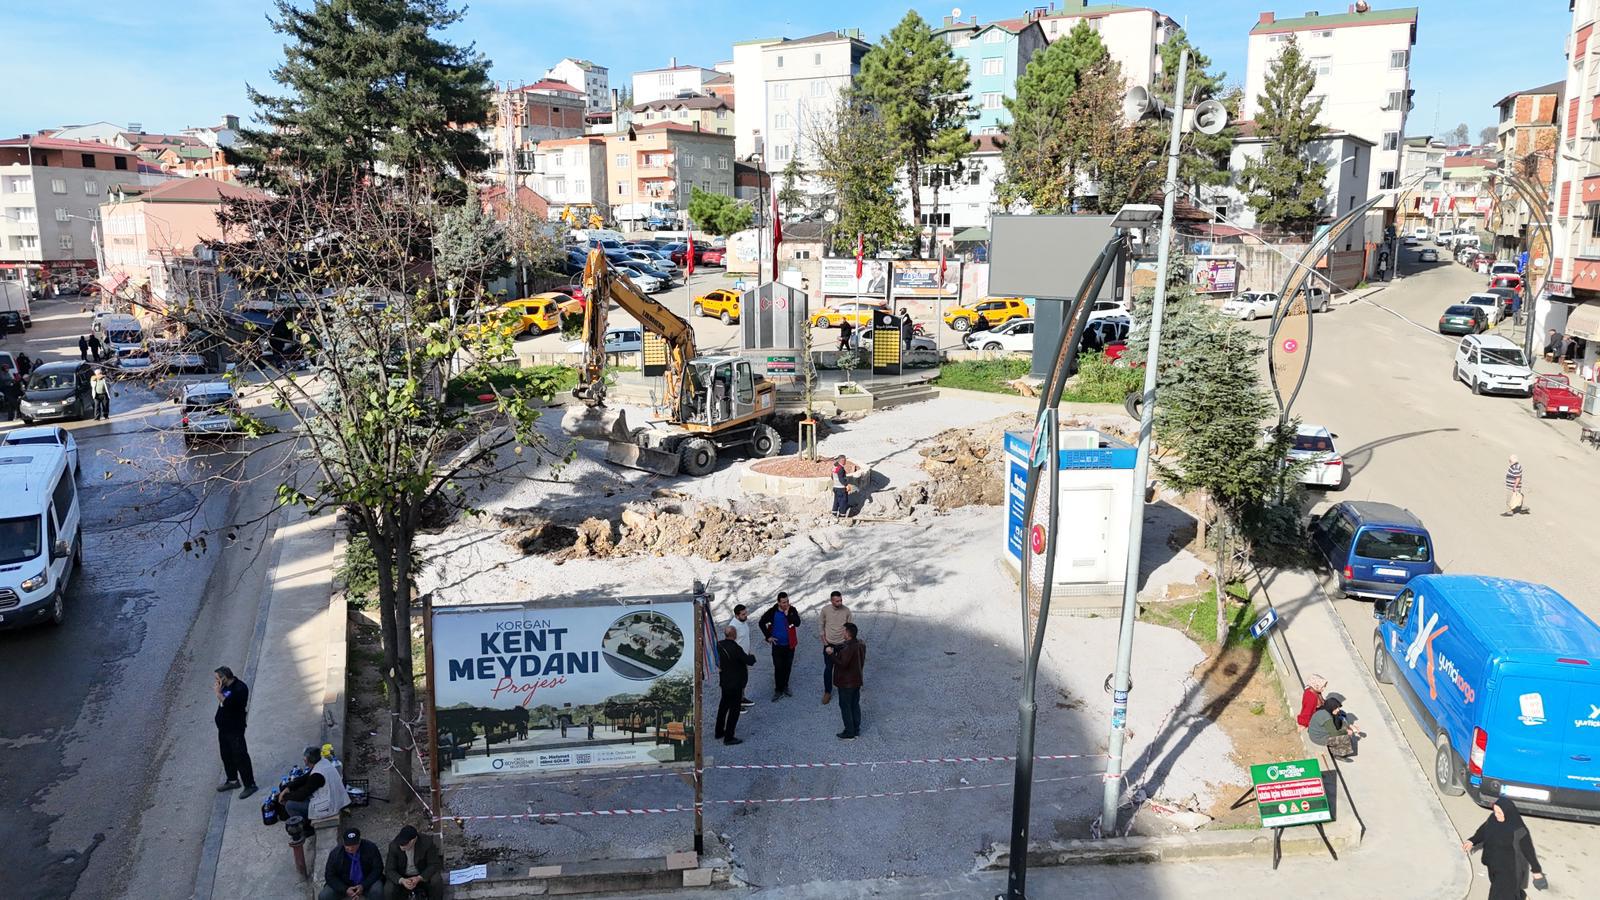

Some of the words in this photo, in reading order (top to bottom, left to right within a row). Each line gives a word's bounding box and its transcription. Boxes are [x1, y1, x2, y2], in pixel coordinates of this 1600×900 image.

[496, 619, 551, 630] KORGAN
[480, 628, 568, 655] KENT
[448, 651, 600, 682] MEYDANI
[491, 675, 568, 707] Projesi
